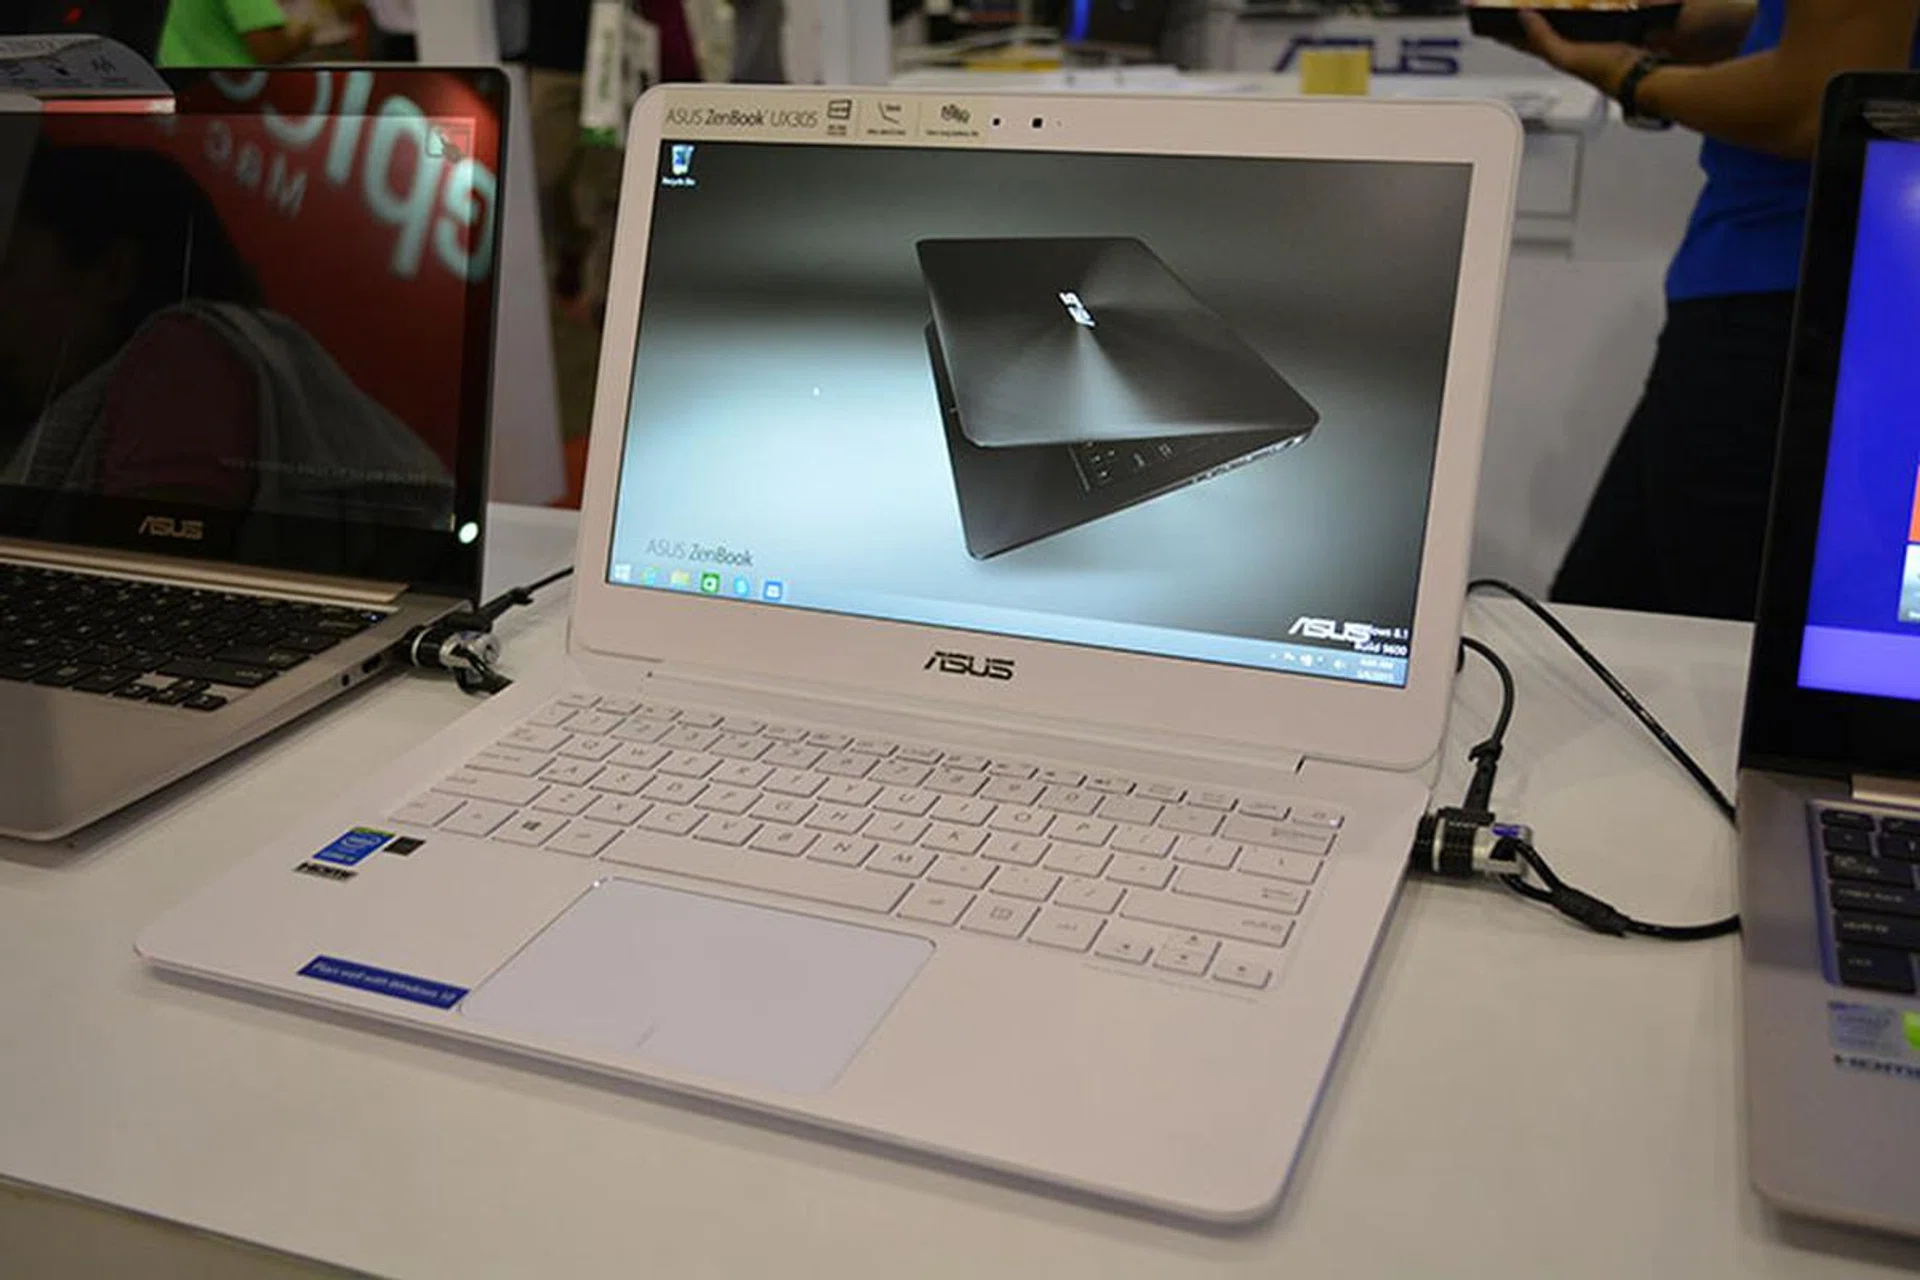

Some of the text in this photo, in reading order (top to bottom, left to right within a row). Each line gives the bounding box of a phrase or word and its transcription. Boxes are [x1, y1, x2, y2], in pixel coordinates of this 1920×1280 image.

[1273, 36, 1461, 75] AUS
[666, 107, 818, 129] ASUS ZenBook UX305
[138, 514, 204, 540] ASUS
[646, 538, 754, 567] ASUS ZenBook
[1287, 616, 1371, 642] ASUS
[923, 650, 1016, 681] ASUS
